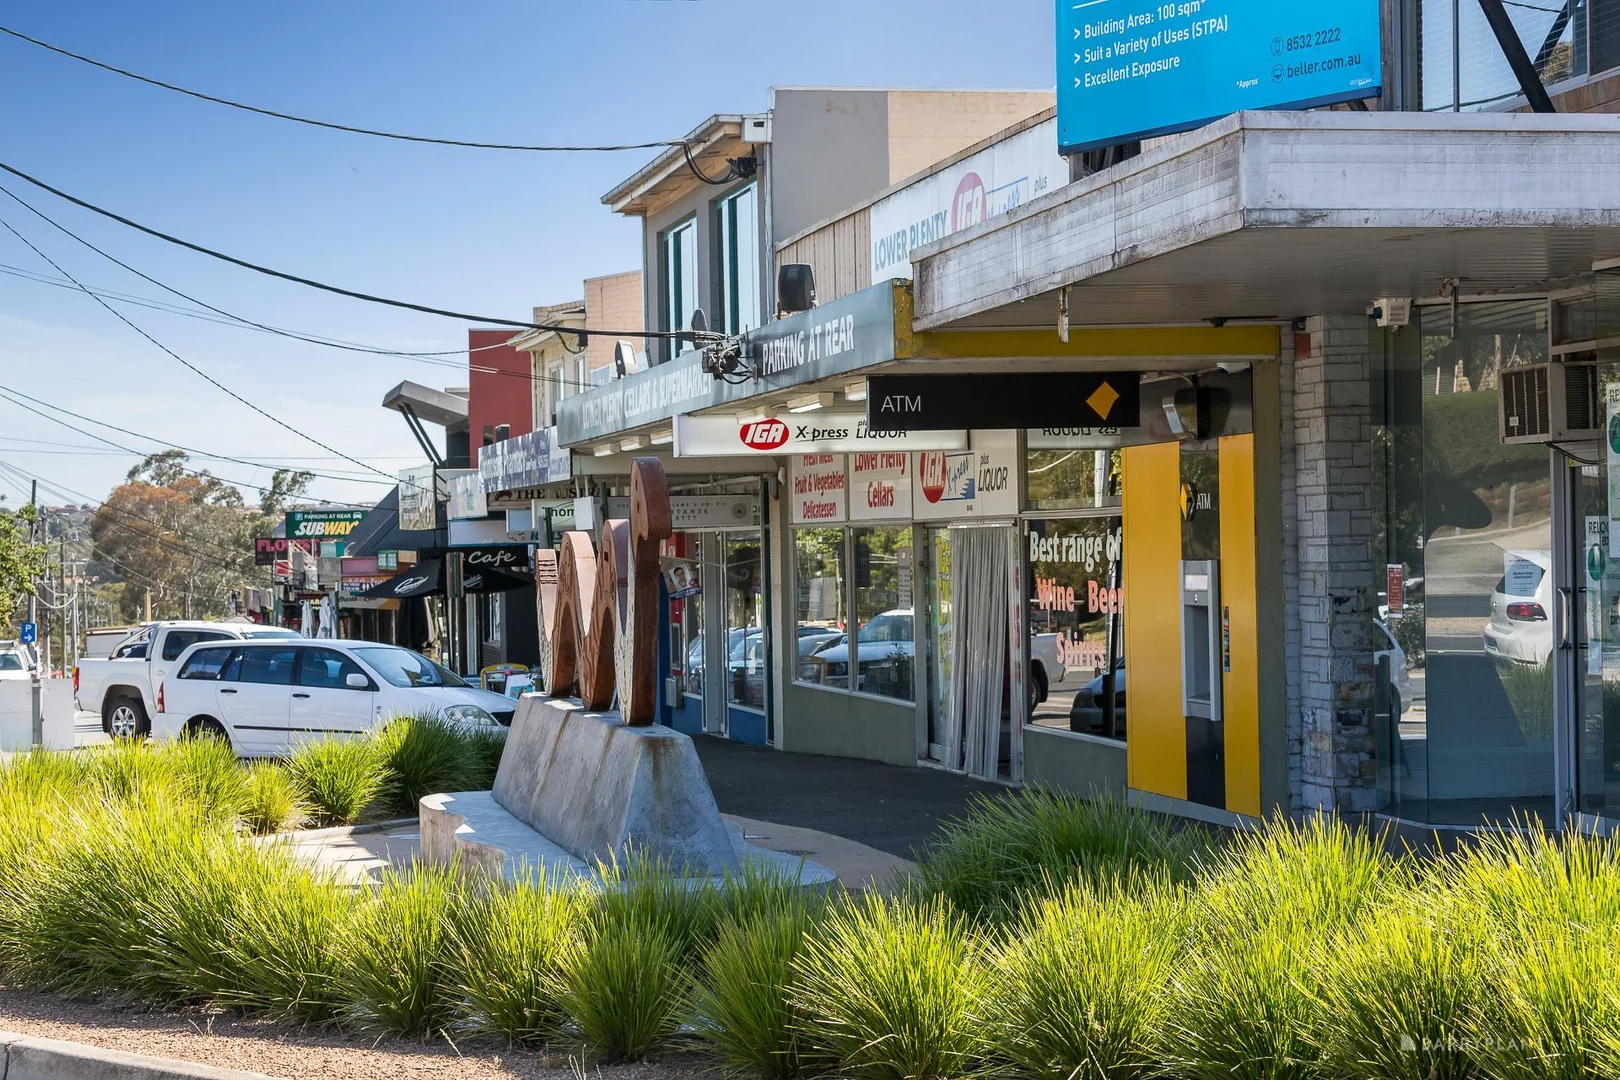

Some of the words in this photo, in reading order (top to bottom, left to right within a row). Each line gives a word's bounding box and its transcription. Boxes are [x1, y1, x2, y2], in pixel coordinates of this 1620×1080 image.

[1084, 19, 1124, 39] Building
[1127, 12, 1154, 29] Area:
[1157, 3, 1176, 21] 100
[1084, 47, 1104, 63] Suit
[1105, 47, 1111, 58] a
[1114, 37, 1149, 56] Variety
[1151, 32, 1161, 48] of
[1163, 28, 1189, 45] Uses
[1192, 14, 1228, 39] (STPA)
[1286, 33, 1312, 52] 8532
[1315, 27, 1341, 46] 2222
[1084, 65, 1130, 88] Excellent
[1132, 56, 1180, 78] Exposure
[1287, 53, 1361, 78] beller.com.au
[874, 228, 908, 272] LOWER
[762, 332, 805, 376] PARKING
[807, 326, 822, 364] AT
[824, 313, 855, 356] REAR
[880, 395, 922, 413] ATM
[745, 423, 785, 444] IGA
[795, 425, 849, 442] X-press
[854, 454, 878, 472] Lower
[880, 453, 907, 475] Plenty
[980, 453, 990, 468] plus
[795, 475, 808, 494] Fruit
[808, 477, 813, 492] &
[813, 472, 845, 496] Vegetables
[978, 467, 1008, 492] LIQUOR
[515, 489, 545, 499] THE
[867, 481, 895, 508] Cellars
[1196, 493, 1211, 510] ATM
[803, 501, 837, 520] Delicatessen
[295, 520, 359, 536] SUBWAY
[468, 550, 517, 568] Cafe
[1030, 532, 1060, 563] Best
[1061, 533, 1103, 573] range
[1106, 526, 1123, 562] of
[1036, 576, 1075, 612] Wine
[25, 624, 32, 633] P
[1056, 631, 1106, 675] Spirits
